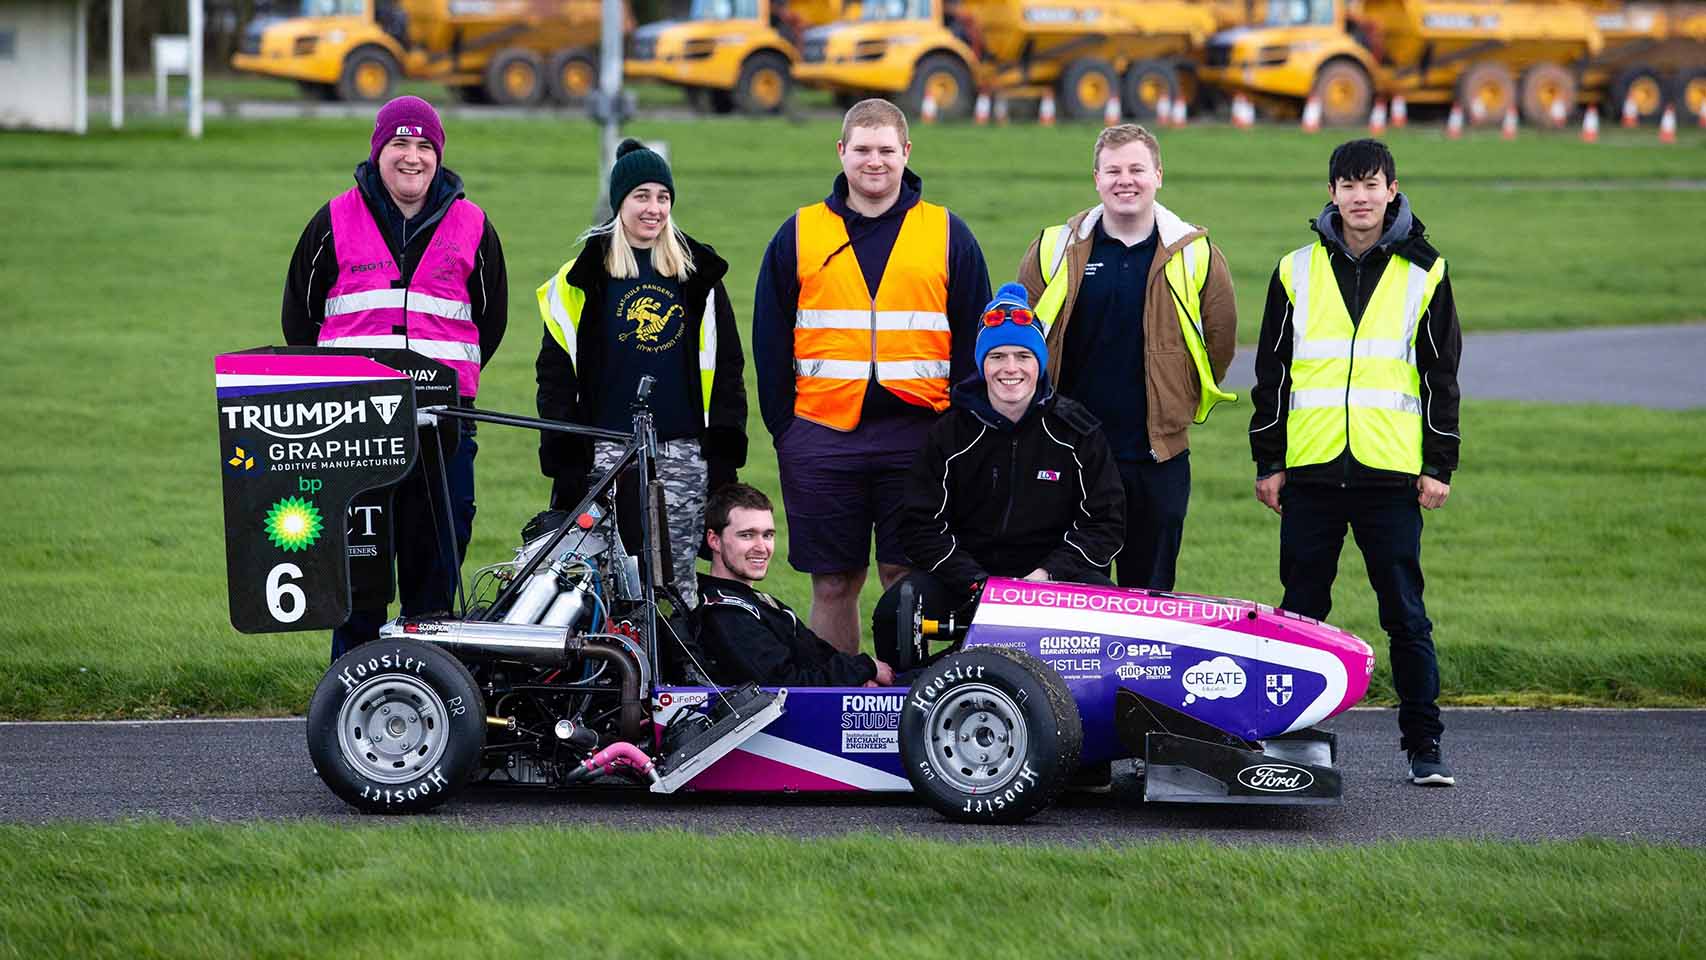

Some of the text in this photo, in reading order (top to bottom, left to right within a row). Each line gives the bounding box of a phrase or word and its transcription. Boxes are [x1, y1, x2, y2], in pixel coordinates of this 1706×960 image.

[222, 400, 366, 438] TRIUMPH
[269, 437, 405, 460] GRAPHITE
[271, 457, 406, 471] ADDITIVE MANUFACTURING
[299, 476, 323, 494] bp
[265, 562, 307, 623] 6
[989, 587, 1242, 622] LOUGHBOROUGH UNI
[418, 622, 449, 632] SCORPION
[1040, 636, 1101, 649] AURORA
[1127, 643, 1172, 656] SPAL
[338, 649, 427, 692] Hoosier
[1146, 665, 1171, 676] STOP
[1185, 672, 1243, 685] CREATE
[911, 661, 985, 714] Hoosier
[447, 695, 466, 717] RR
[842, 695, 907, 711] FORMU
[841, 712, 902, 729] STUDE
[919, 761, 935, 781] LU3
[1250, 766, 1301, 789] Ford
[360, 766, 449, 808] Hoosier
[963, 759, 1039, 815] Hoosier
